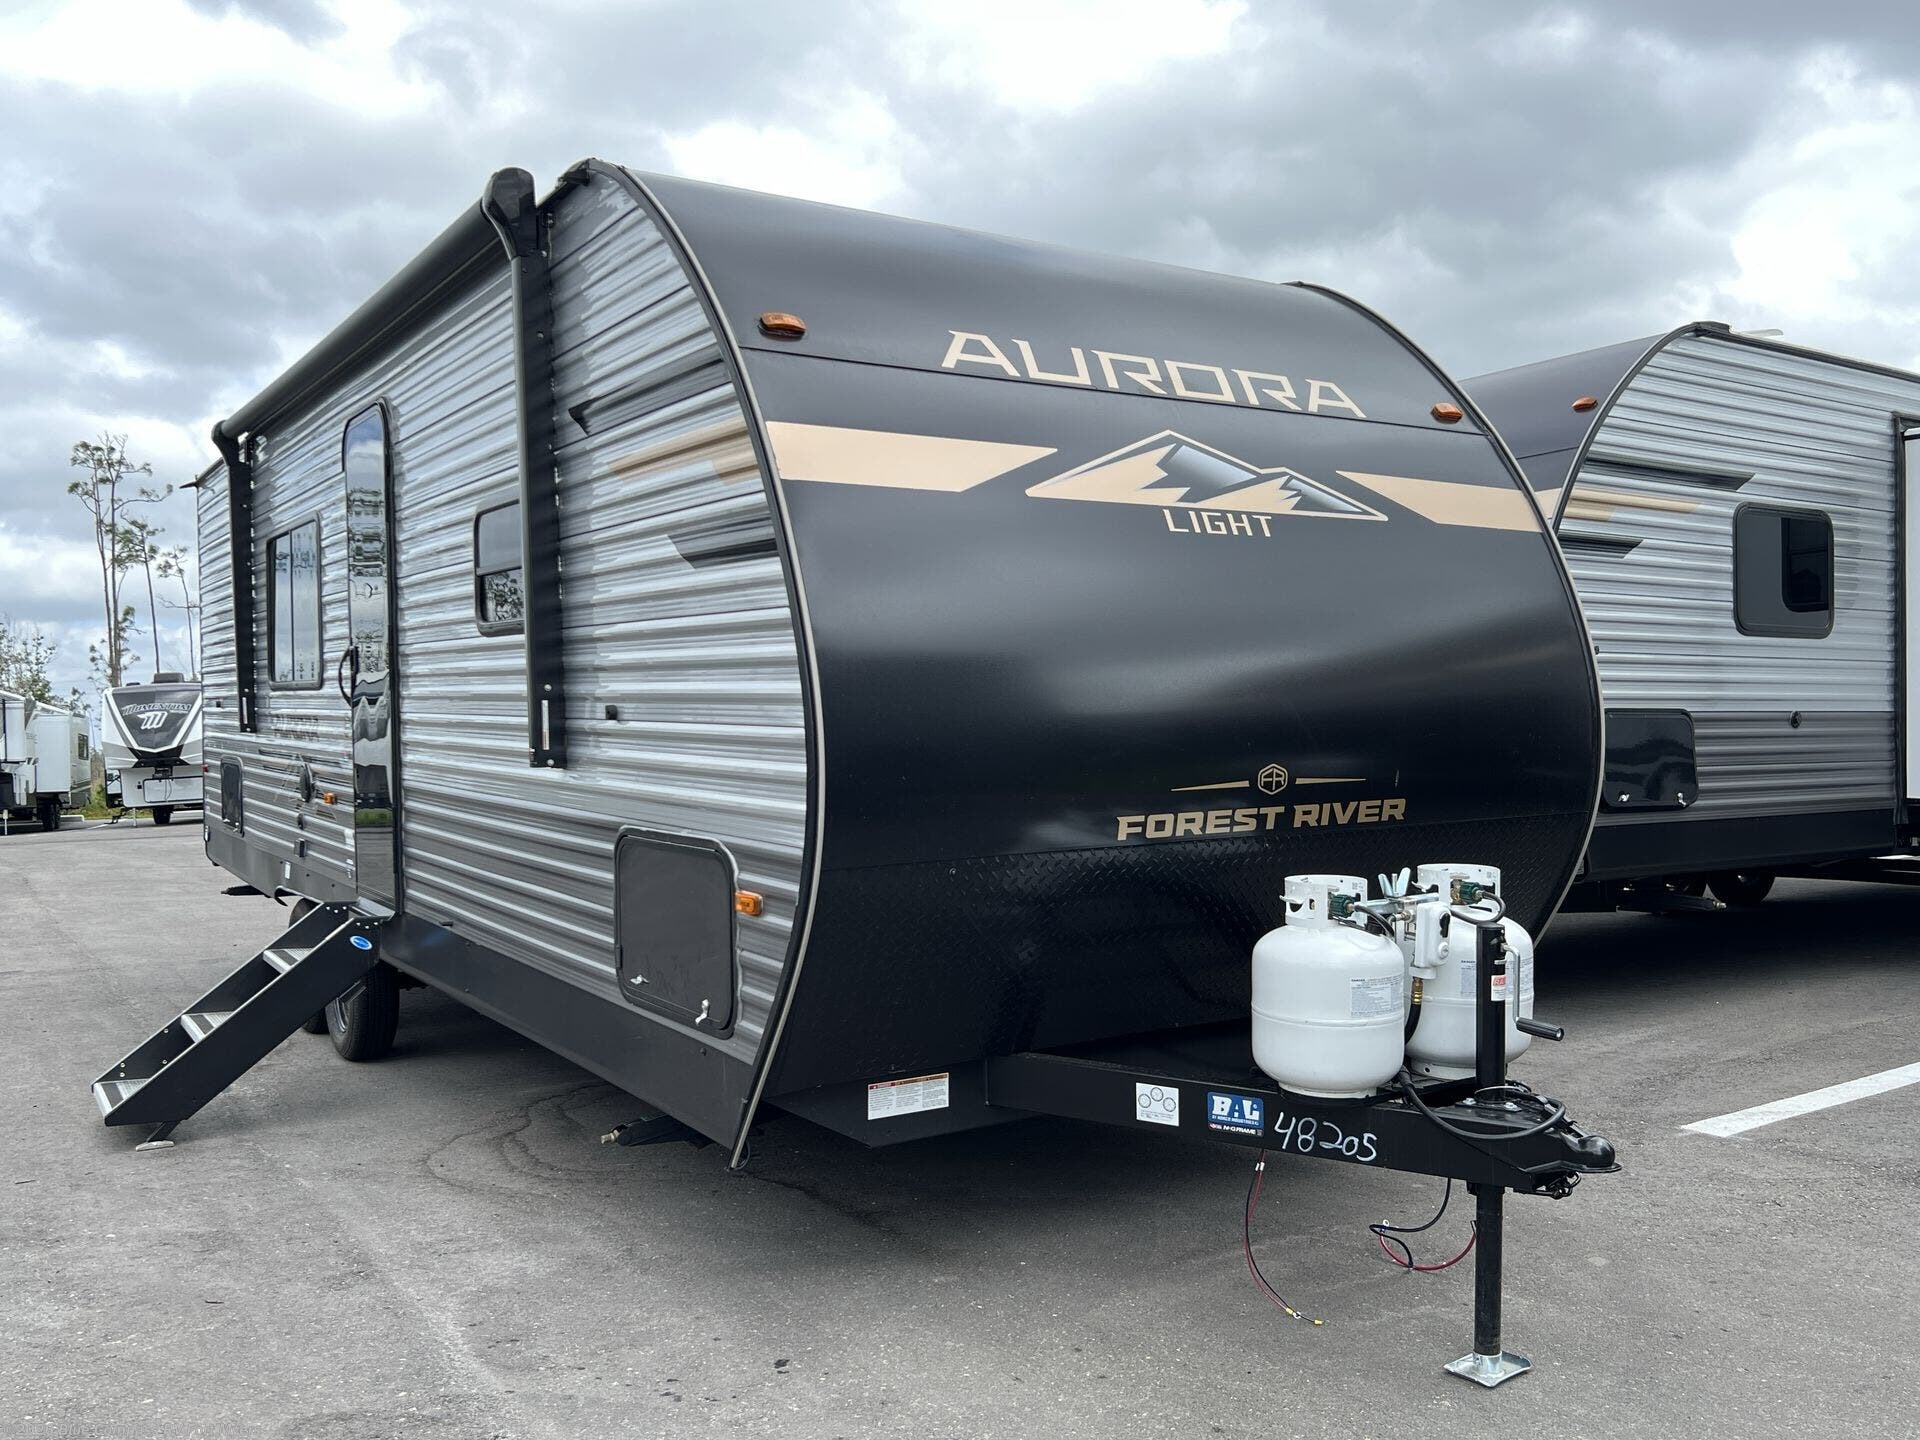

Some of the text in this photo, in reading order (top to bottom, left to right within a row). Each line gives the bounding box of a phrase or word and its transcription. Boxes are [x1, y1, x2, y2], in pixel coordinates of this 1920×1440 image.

[940, 329, 1367, 419] AURORA
[1162, 508, 1273, 538] LIGHT
[1116, 798, 1407, 841] FOREST RIVER
[1212, 1095, 1260, 1121] BAL
[1273, 1111, 1379, 1162] 48205
